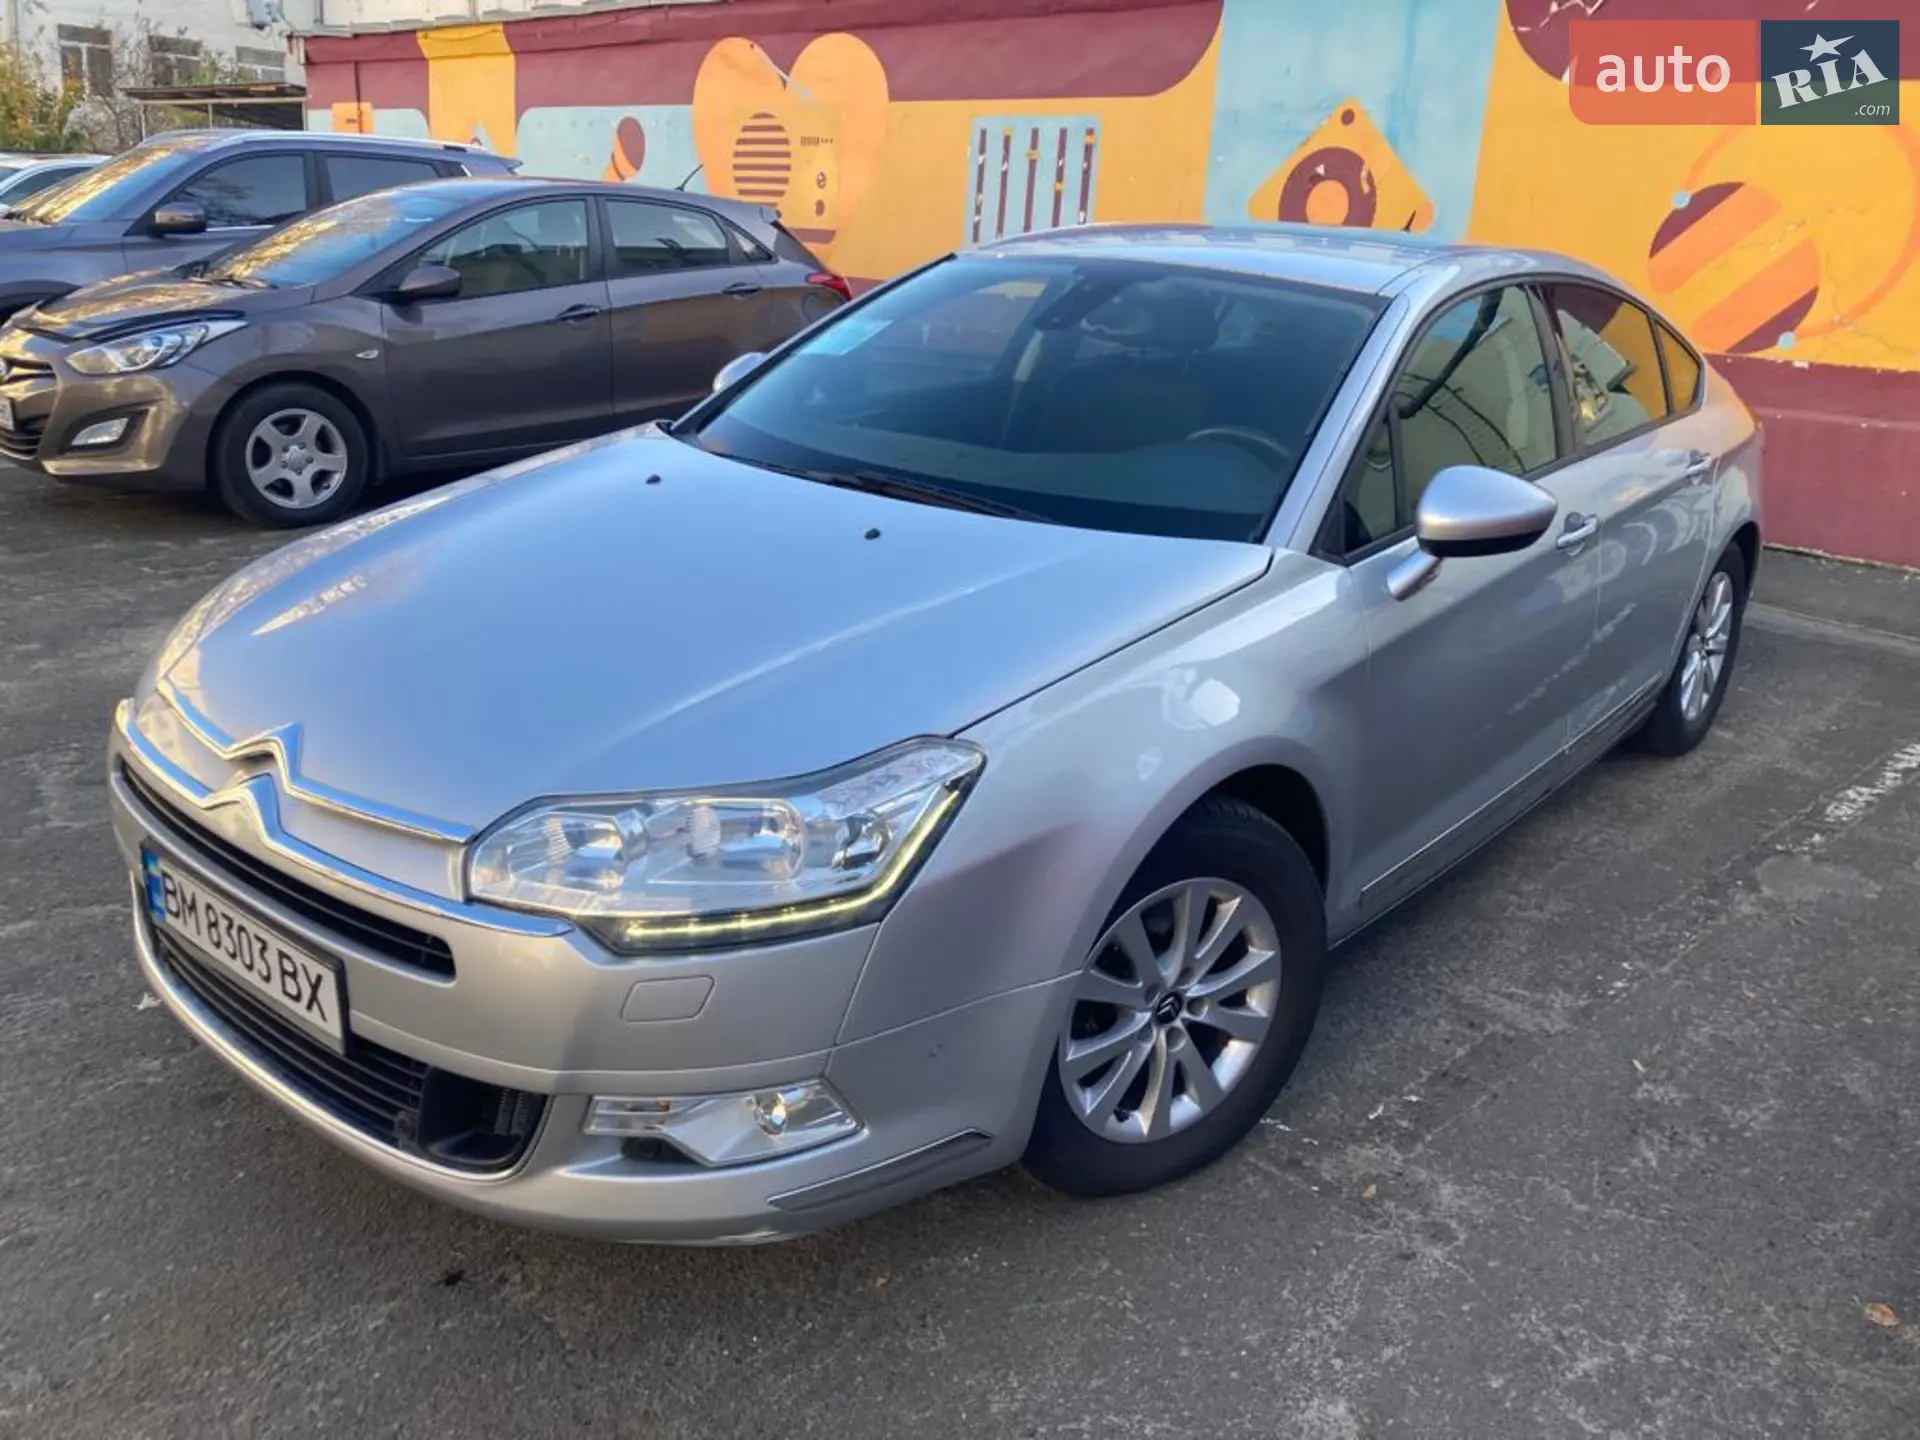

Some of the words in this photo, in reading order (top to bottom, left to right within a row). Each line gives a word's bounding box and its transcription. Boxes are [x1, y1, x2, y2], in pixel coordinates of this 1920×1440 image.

[161, 870, 201, 937] BM
[205, 902, 271, 984] 8303
[277, 947, 328, 1023] BX
